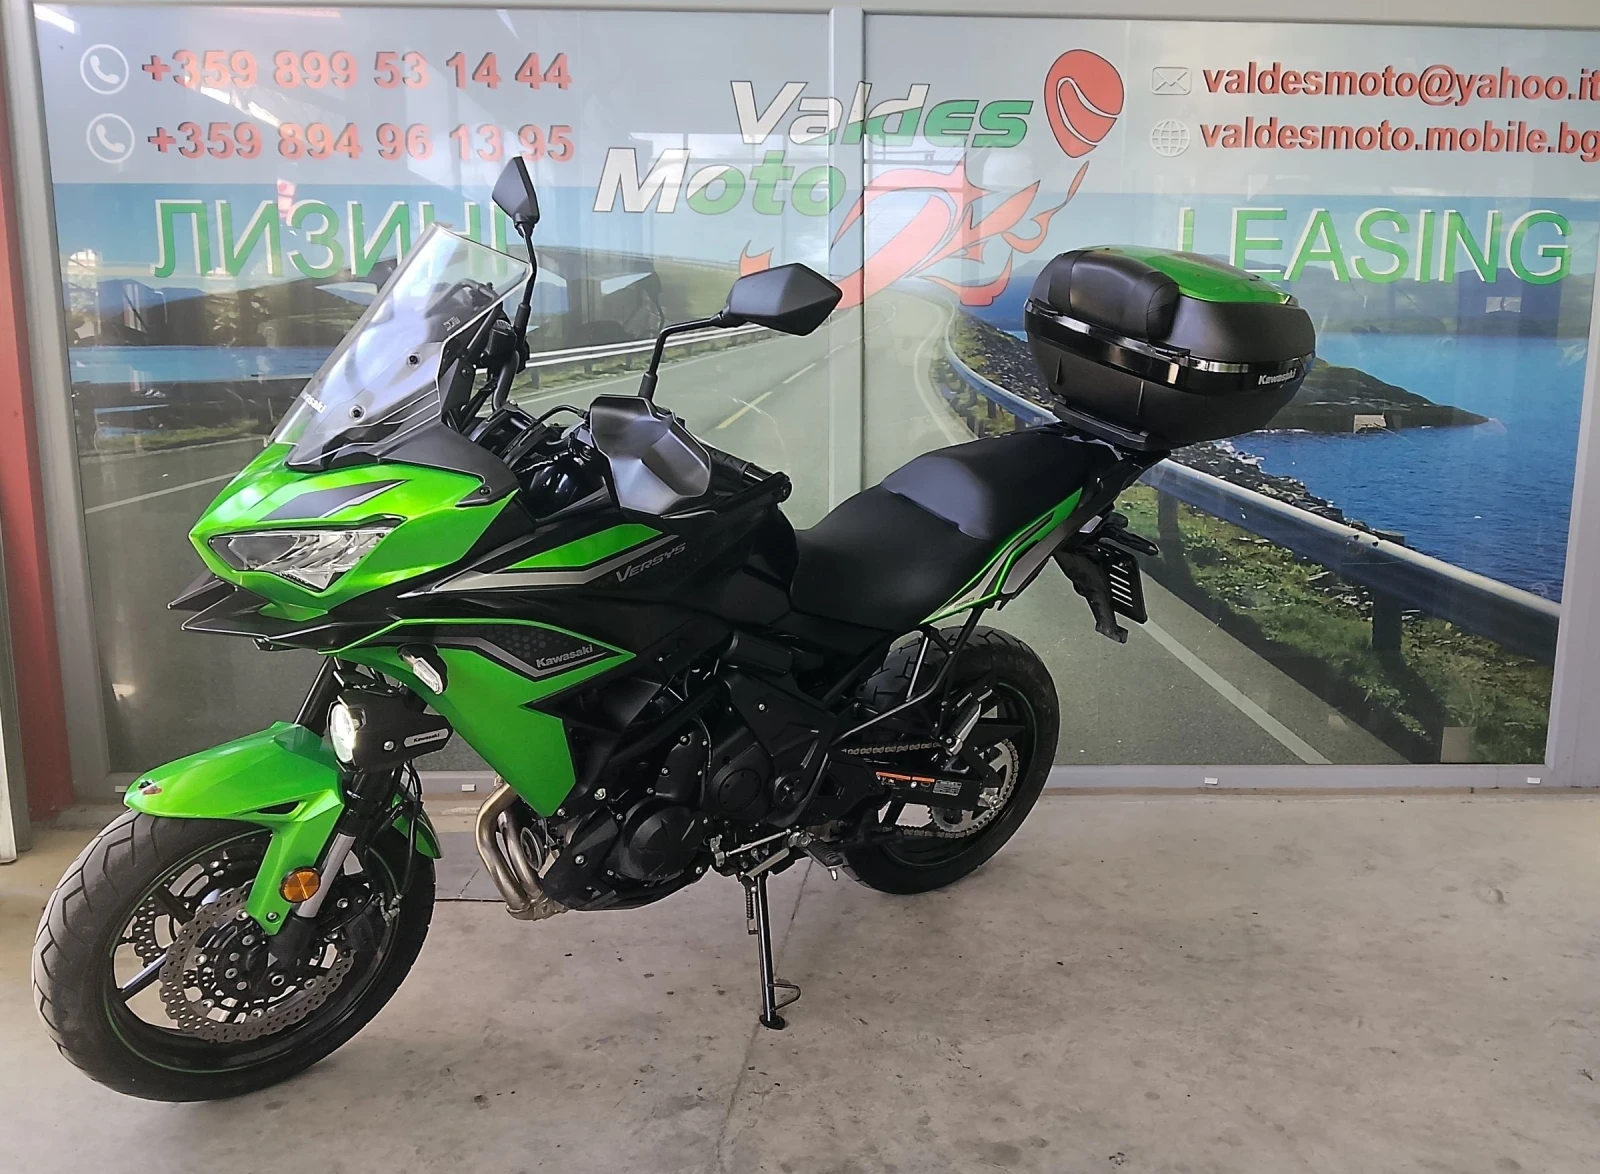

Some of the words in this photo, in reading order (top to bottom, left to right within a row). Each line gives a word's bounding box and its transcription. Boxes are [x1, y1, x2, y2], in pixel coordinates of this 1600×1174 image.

[142, 49, 258, 89] +359
[273, 50, 358, 89] 899
[374, 51, 430, 89] 53
[446, 51, 501, 90] 14
[515, 52, 572, 90] 44
[1202, 62, 1600, 106] valdesmoto@yahoo.it
[730, 80, 1034, 148] Valdes
[148, 121, 262, 159] +359
[278, 122, 363, 160] 894
[376, 122, 433, 160] 96
[449, 123, 501, 161] 13
[518, 124, 575, 162] 95
[1200, 117, 1600, 162] valdesmoto.mobile.bg
[593, 147, 846, 216] Moto
[1258, 367, 1297, 385] Kawasaki
[536, 644, 594, 668] Kawasaki
